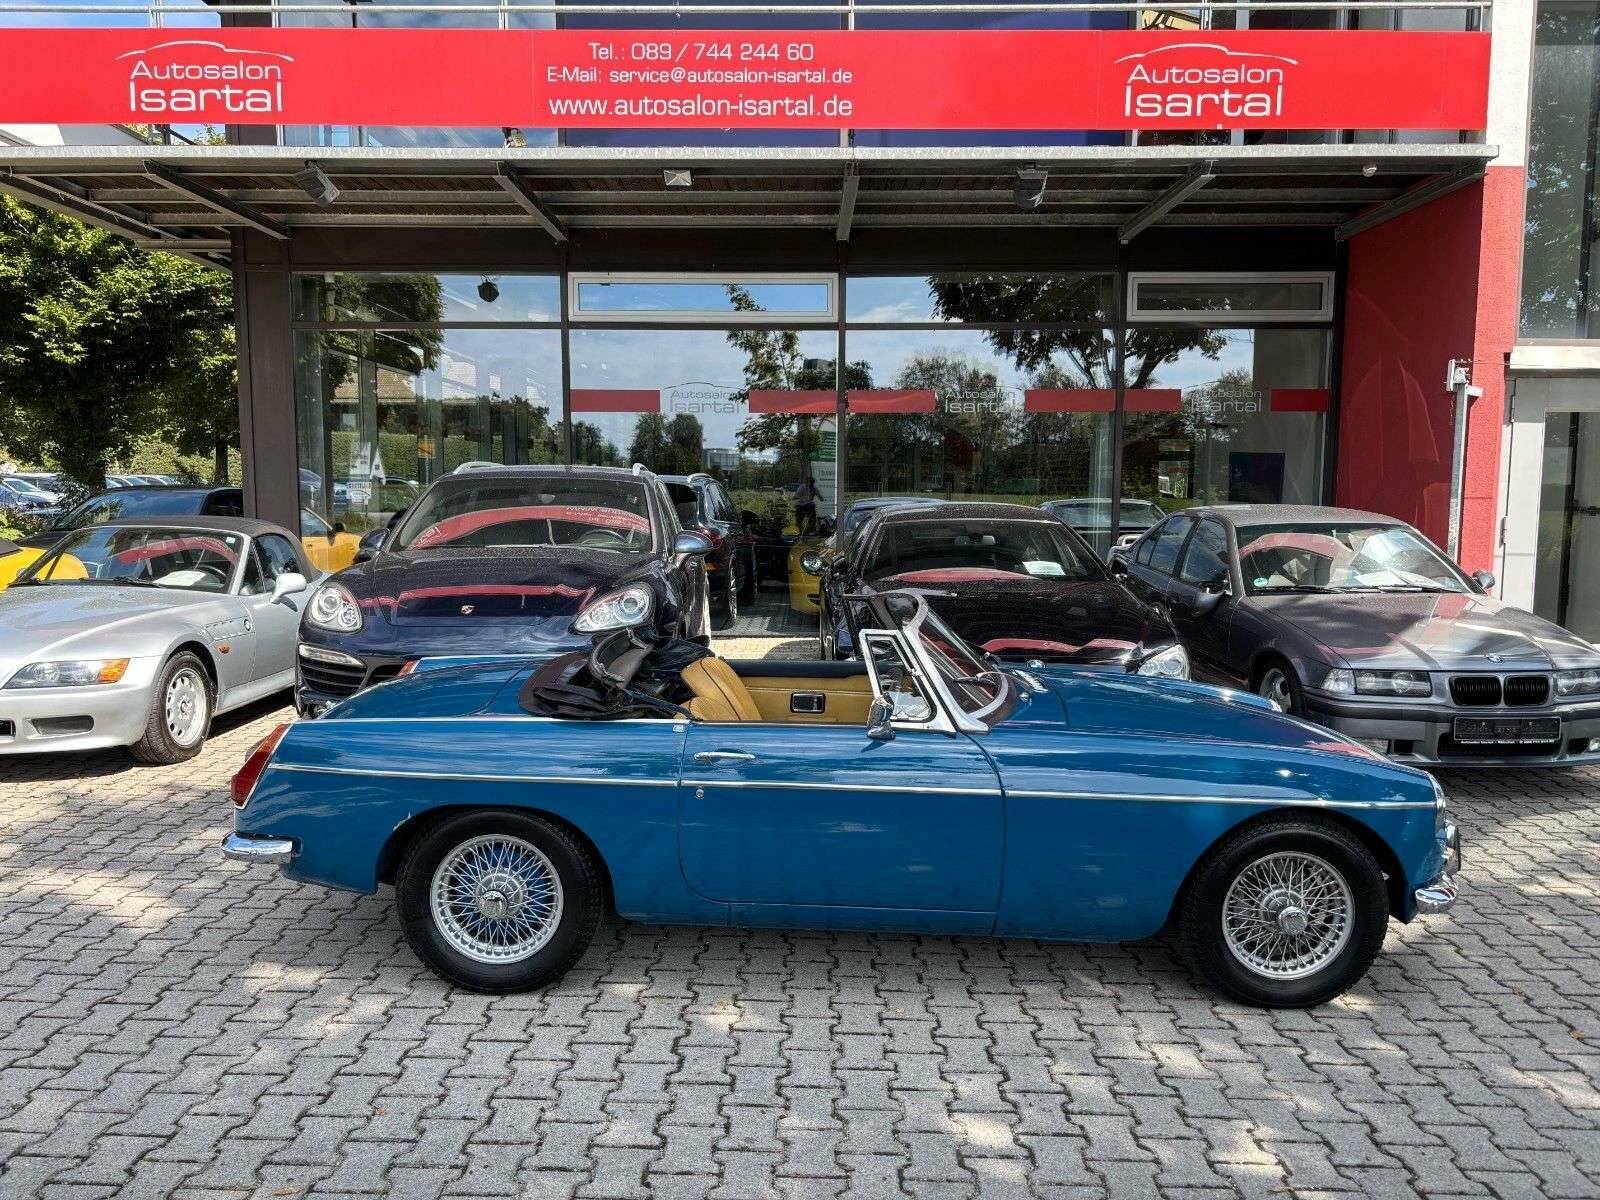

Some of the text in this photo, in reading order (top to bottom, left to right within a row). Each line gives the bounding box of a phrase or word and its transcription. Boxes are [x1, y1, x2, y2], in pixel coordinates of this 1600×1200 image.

[588, 43, 814, 62] Tel.: 089 / 744 244 60
[130, 60, 282, 80] Autosalon
[547, 66, 853, 84] E-Mail: service@autosalon-isartal.de
[1127, 64, 1284, 84] Autosalon
[129, 80, 283, 113] Isartal
[548, 94, 853, 117] www.autosalon-isartal.de
[1124, 85, 1283, 118] Isartal
[671, 389, 739, 399] Autosalo
